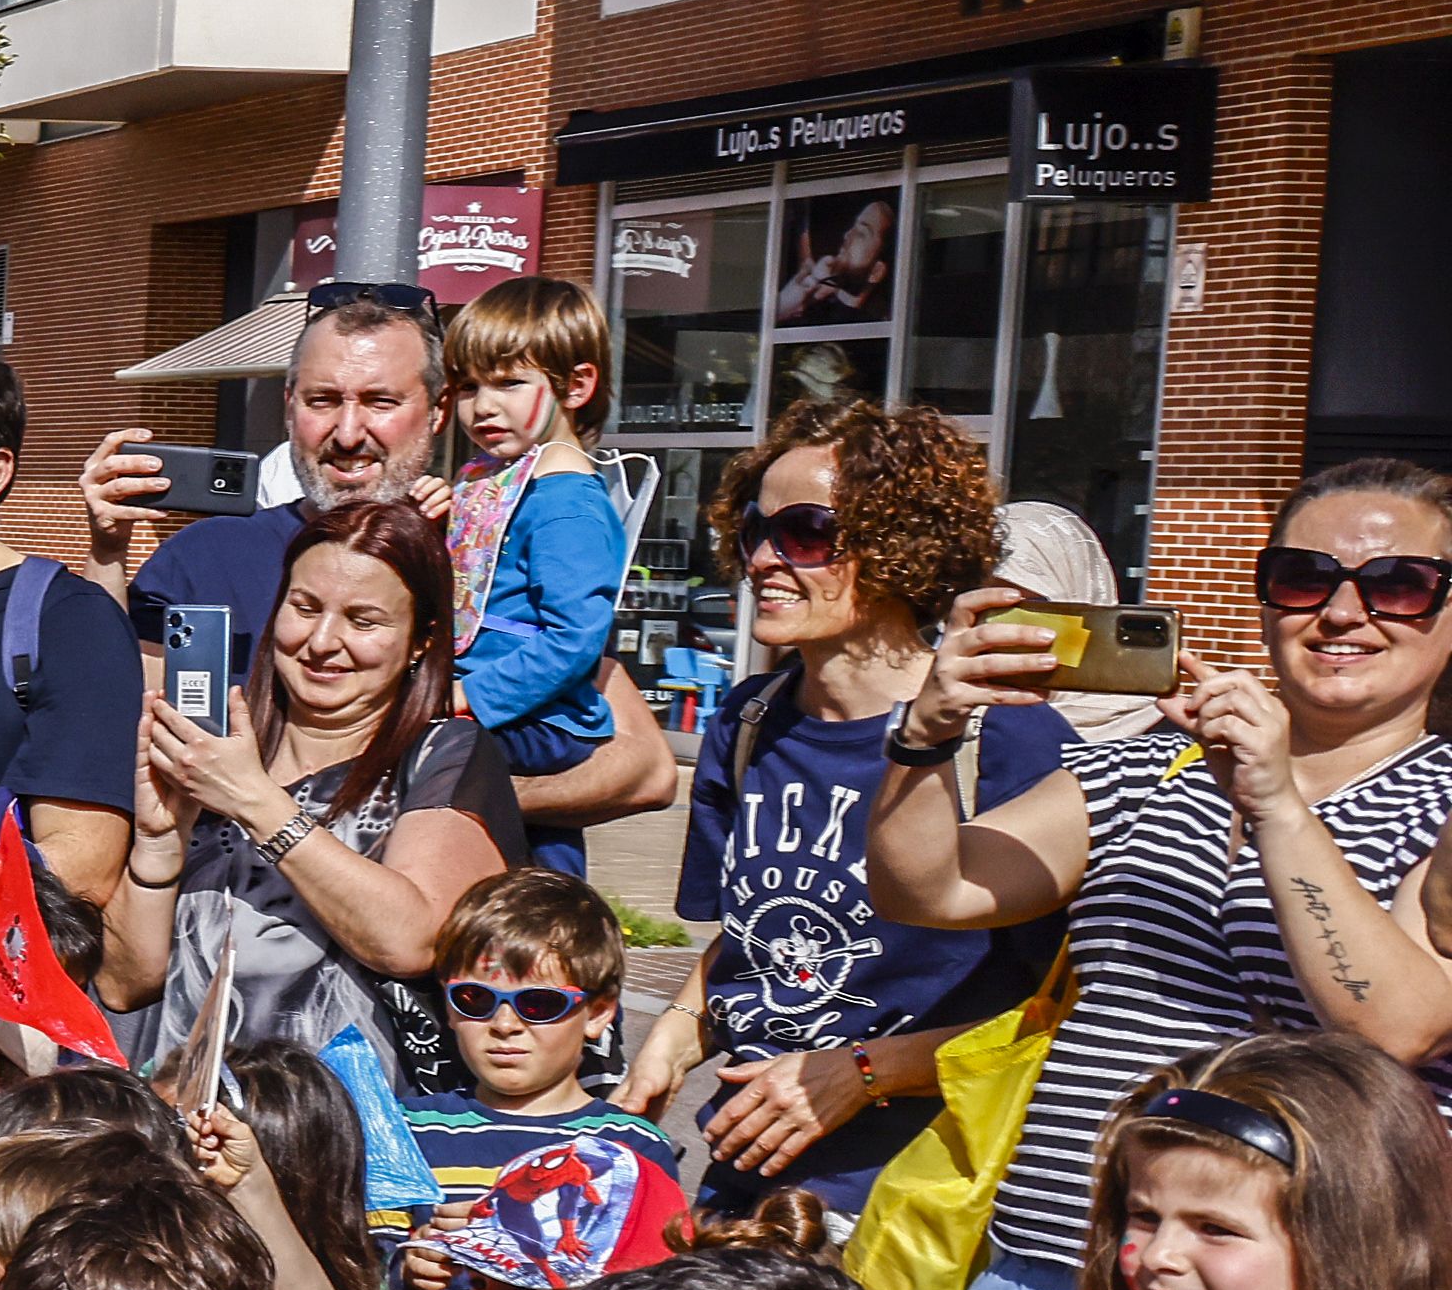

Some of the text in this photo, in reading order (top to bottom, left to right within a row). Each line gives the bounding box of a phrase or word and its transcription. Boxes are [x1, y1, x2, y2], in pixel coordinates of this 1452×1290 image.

[788, 108, 906, 149] Peluqueros
[1034, 162, 1177, 192] Peluqueros
[732, 866, 874, 926] MOUSE
